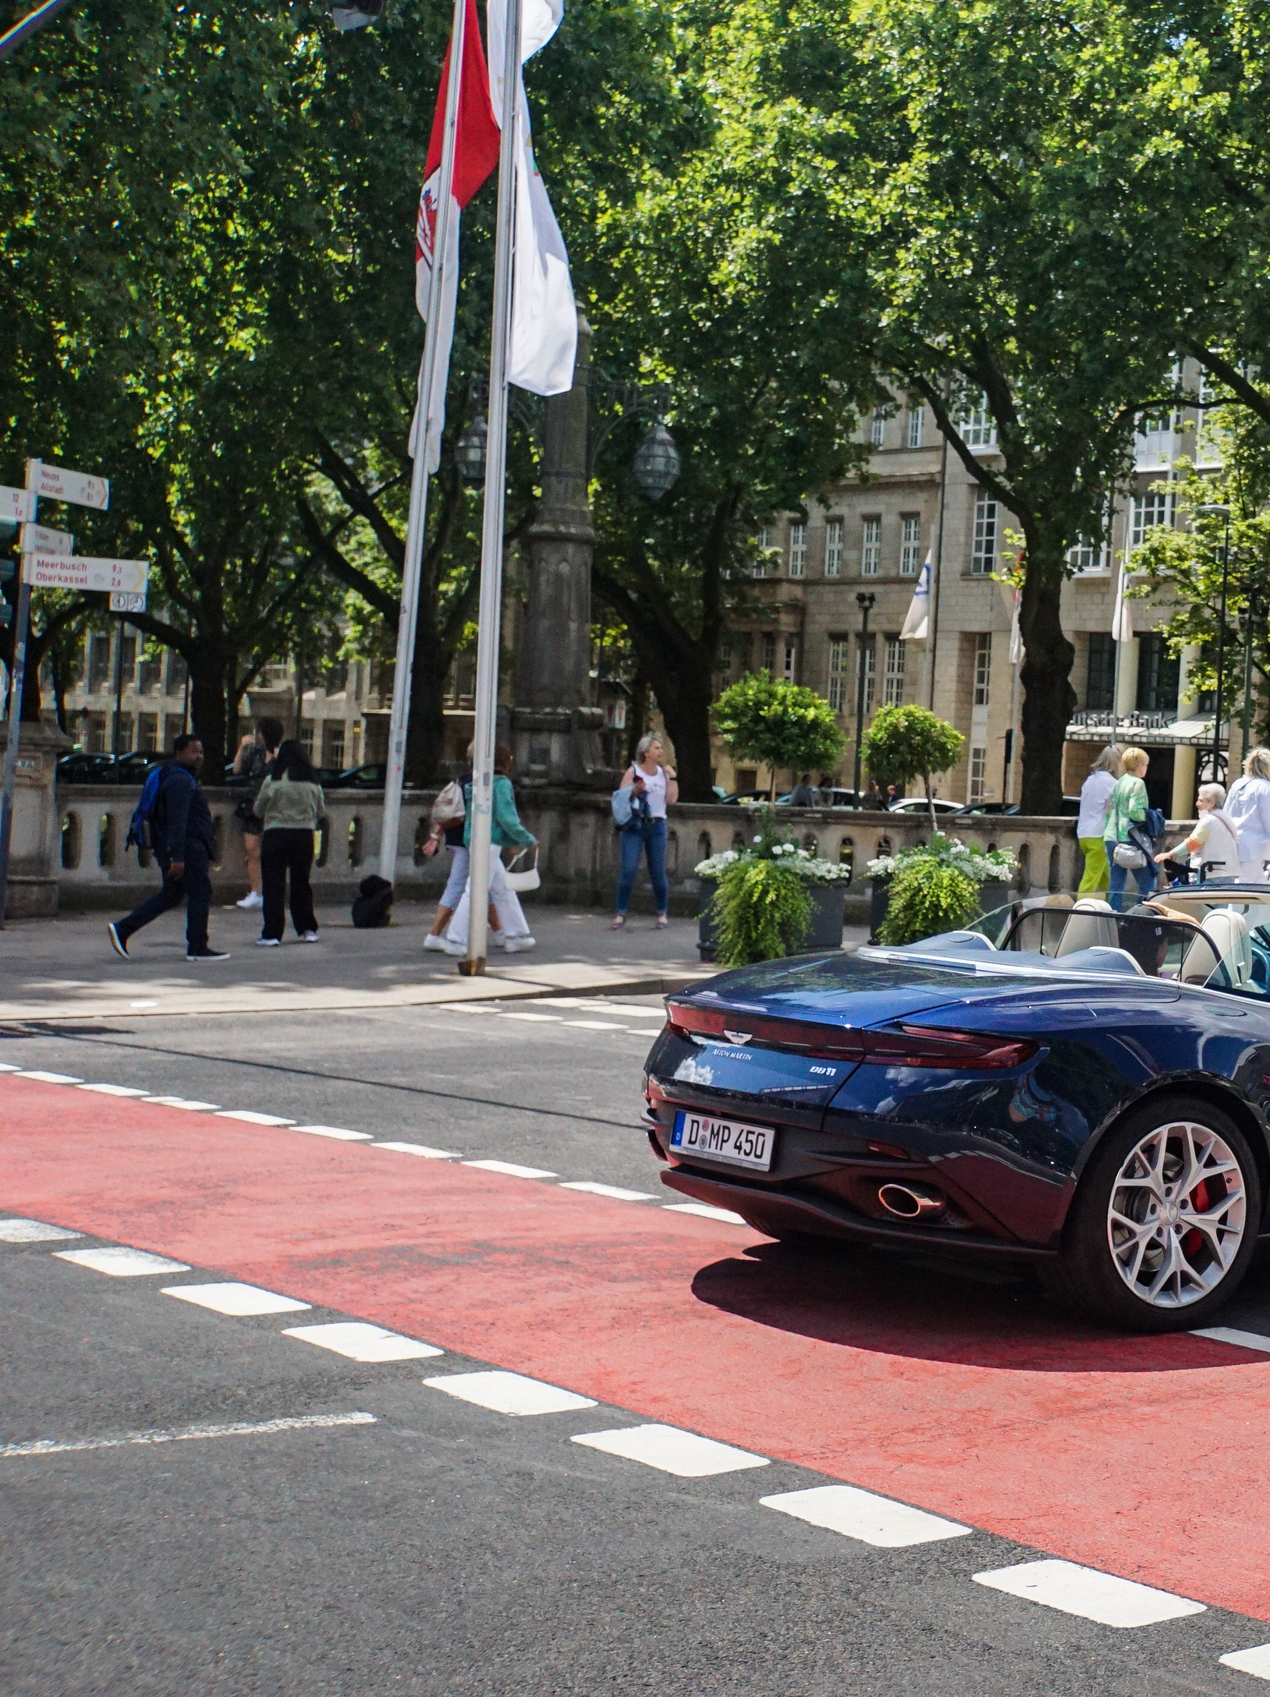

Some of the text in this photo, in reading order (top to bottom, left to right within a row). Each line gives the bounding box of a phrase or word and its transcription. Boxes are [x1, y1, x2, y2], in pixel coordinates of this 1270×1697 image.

[40, 482, 64, 495] Altstadt
[36, 559, 87, 572] Meerbusch
[35, 571, 88, 585] Oberkassel
[1129, 710, 1167, 729] Bank
[712, 1048, 753, 1061] ASTON MARTIN
[809, 1065, 837, 1077] DB11
[688, 1118, 766, 1159] D MP 450
